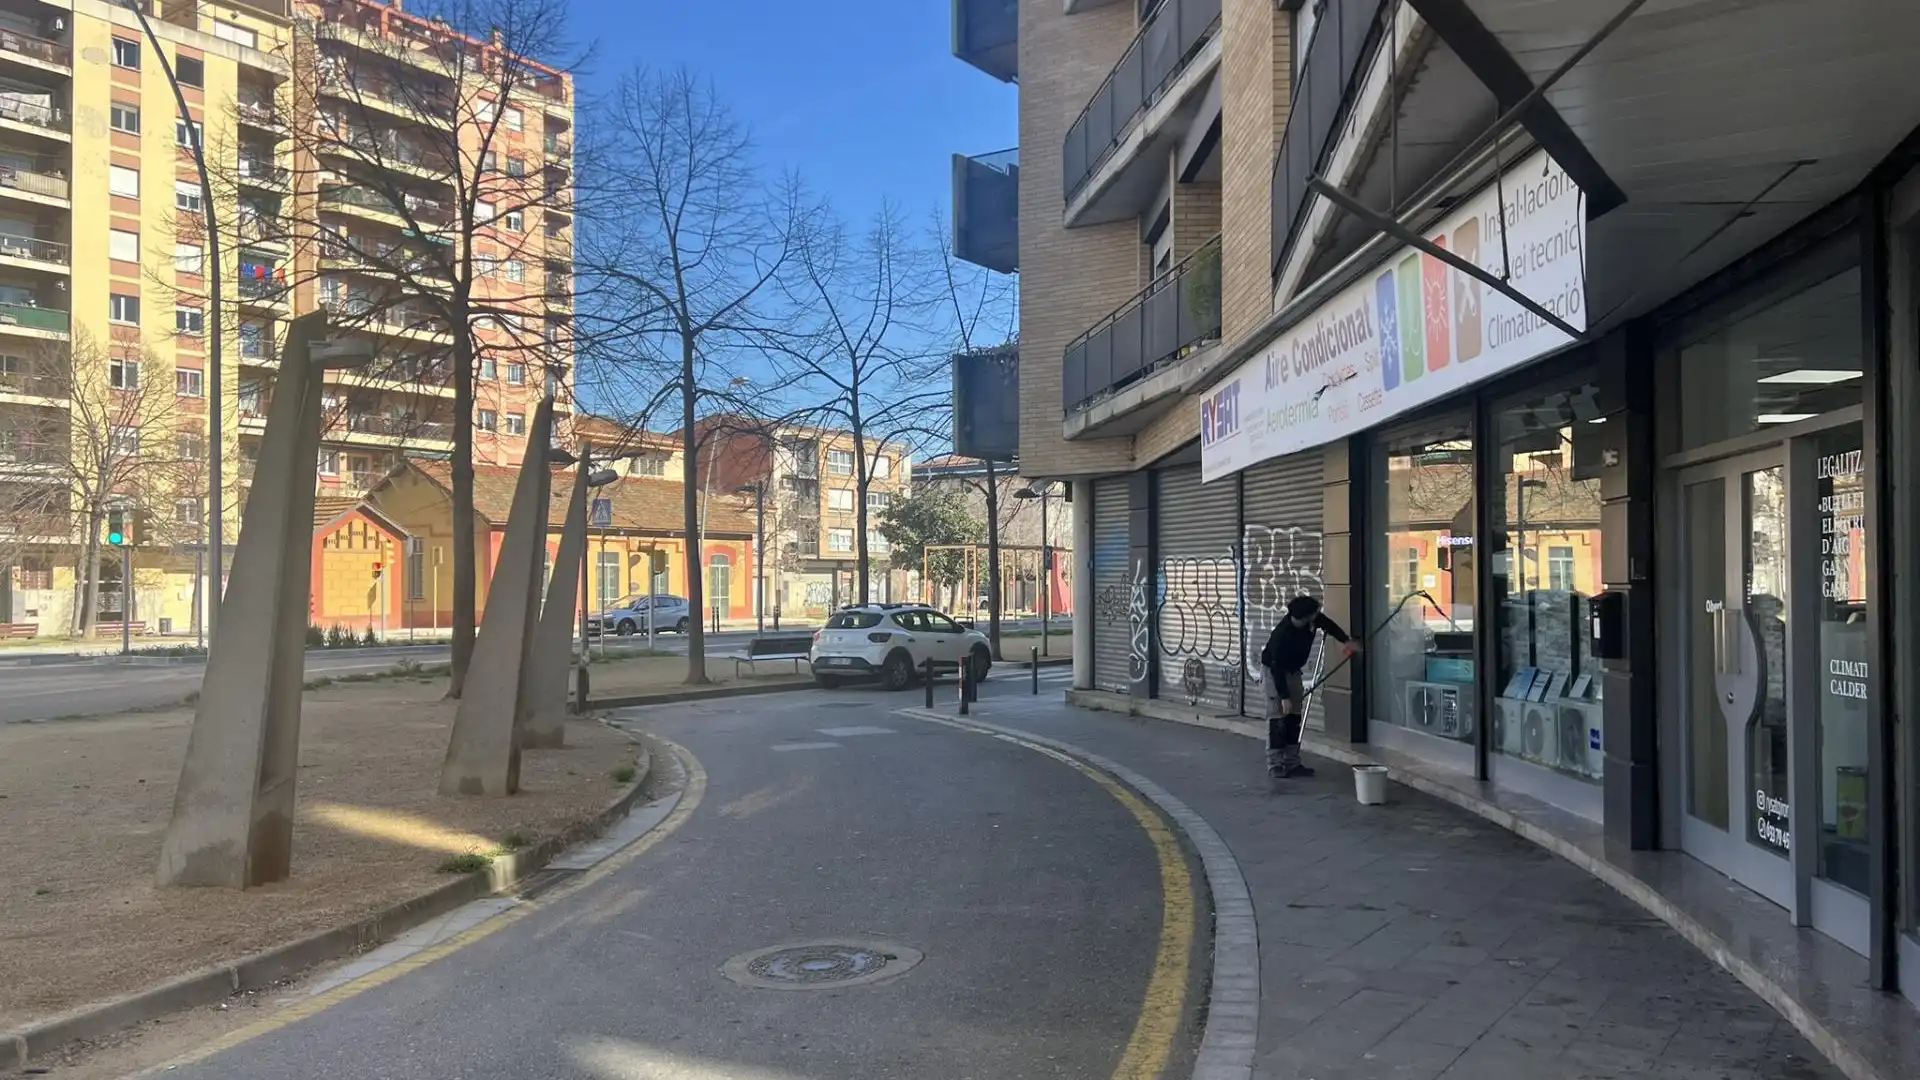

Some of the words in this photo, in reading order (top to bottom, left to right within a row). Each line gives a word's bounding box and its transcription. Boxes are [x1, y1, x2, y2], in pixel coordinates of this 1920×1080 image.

[1265, 349, 1289, 393] Aire
[1292, 292, 1374, 378] Condicionat
[1266, 391, 1320, 434] Aerotermia
[1830, 679, 1867, 699] CALDER
